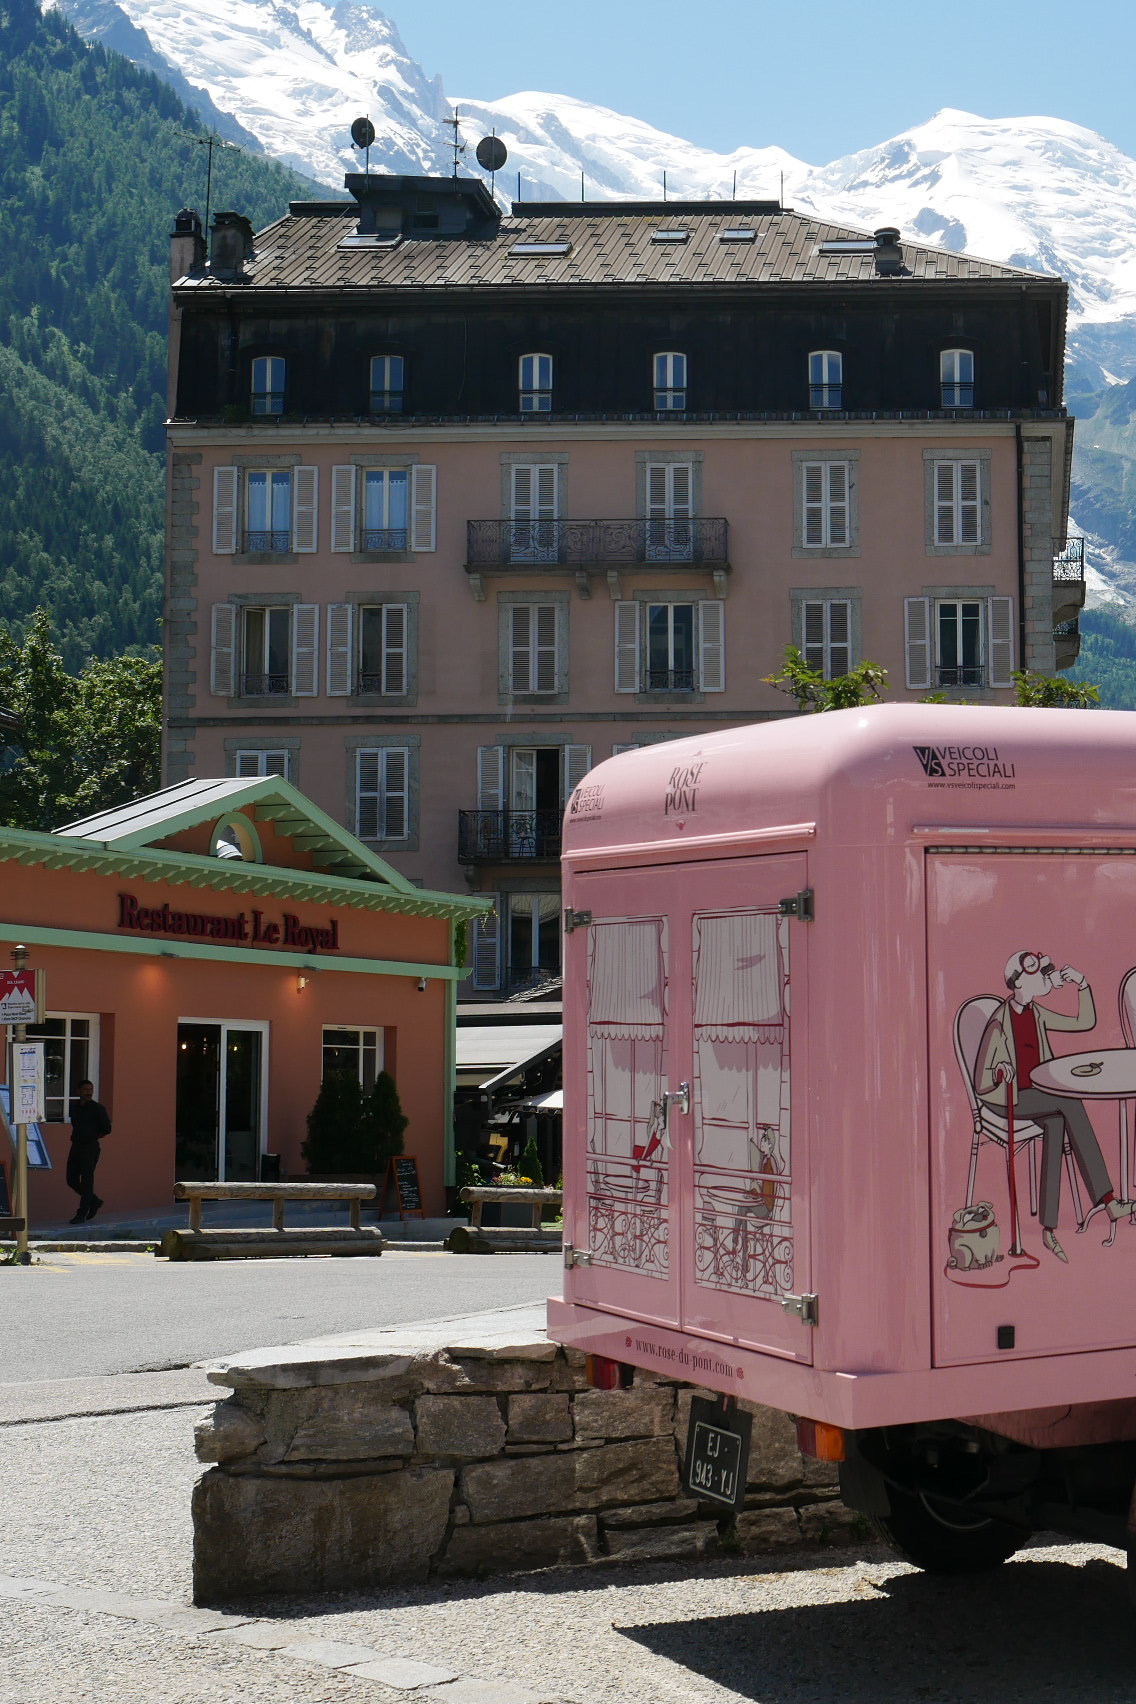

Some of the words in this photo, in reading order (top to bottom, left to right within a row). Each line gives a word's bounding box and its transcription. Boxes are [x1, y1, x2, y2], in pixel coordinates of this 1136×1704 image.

[936, 746, 999, 761] VEICOLI
[667, 762, 708, 789] ROSE
[947, 762, 1016, 778] SPECIALI
[927, 781, 1016, 791] www.vsveicolispeciali.com
[664, 788, 699, 815] PONT
[118, 893, 248, 940] Restaurant
[252, 910, 281, 944] Le
[283, 913, 340, 953] Royal
[635, 1339, 733, 1377] www.rose-du-pont.com
